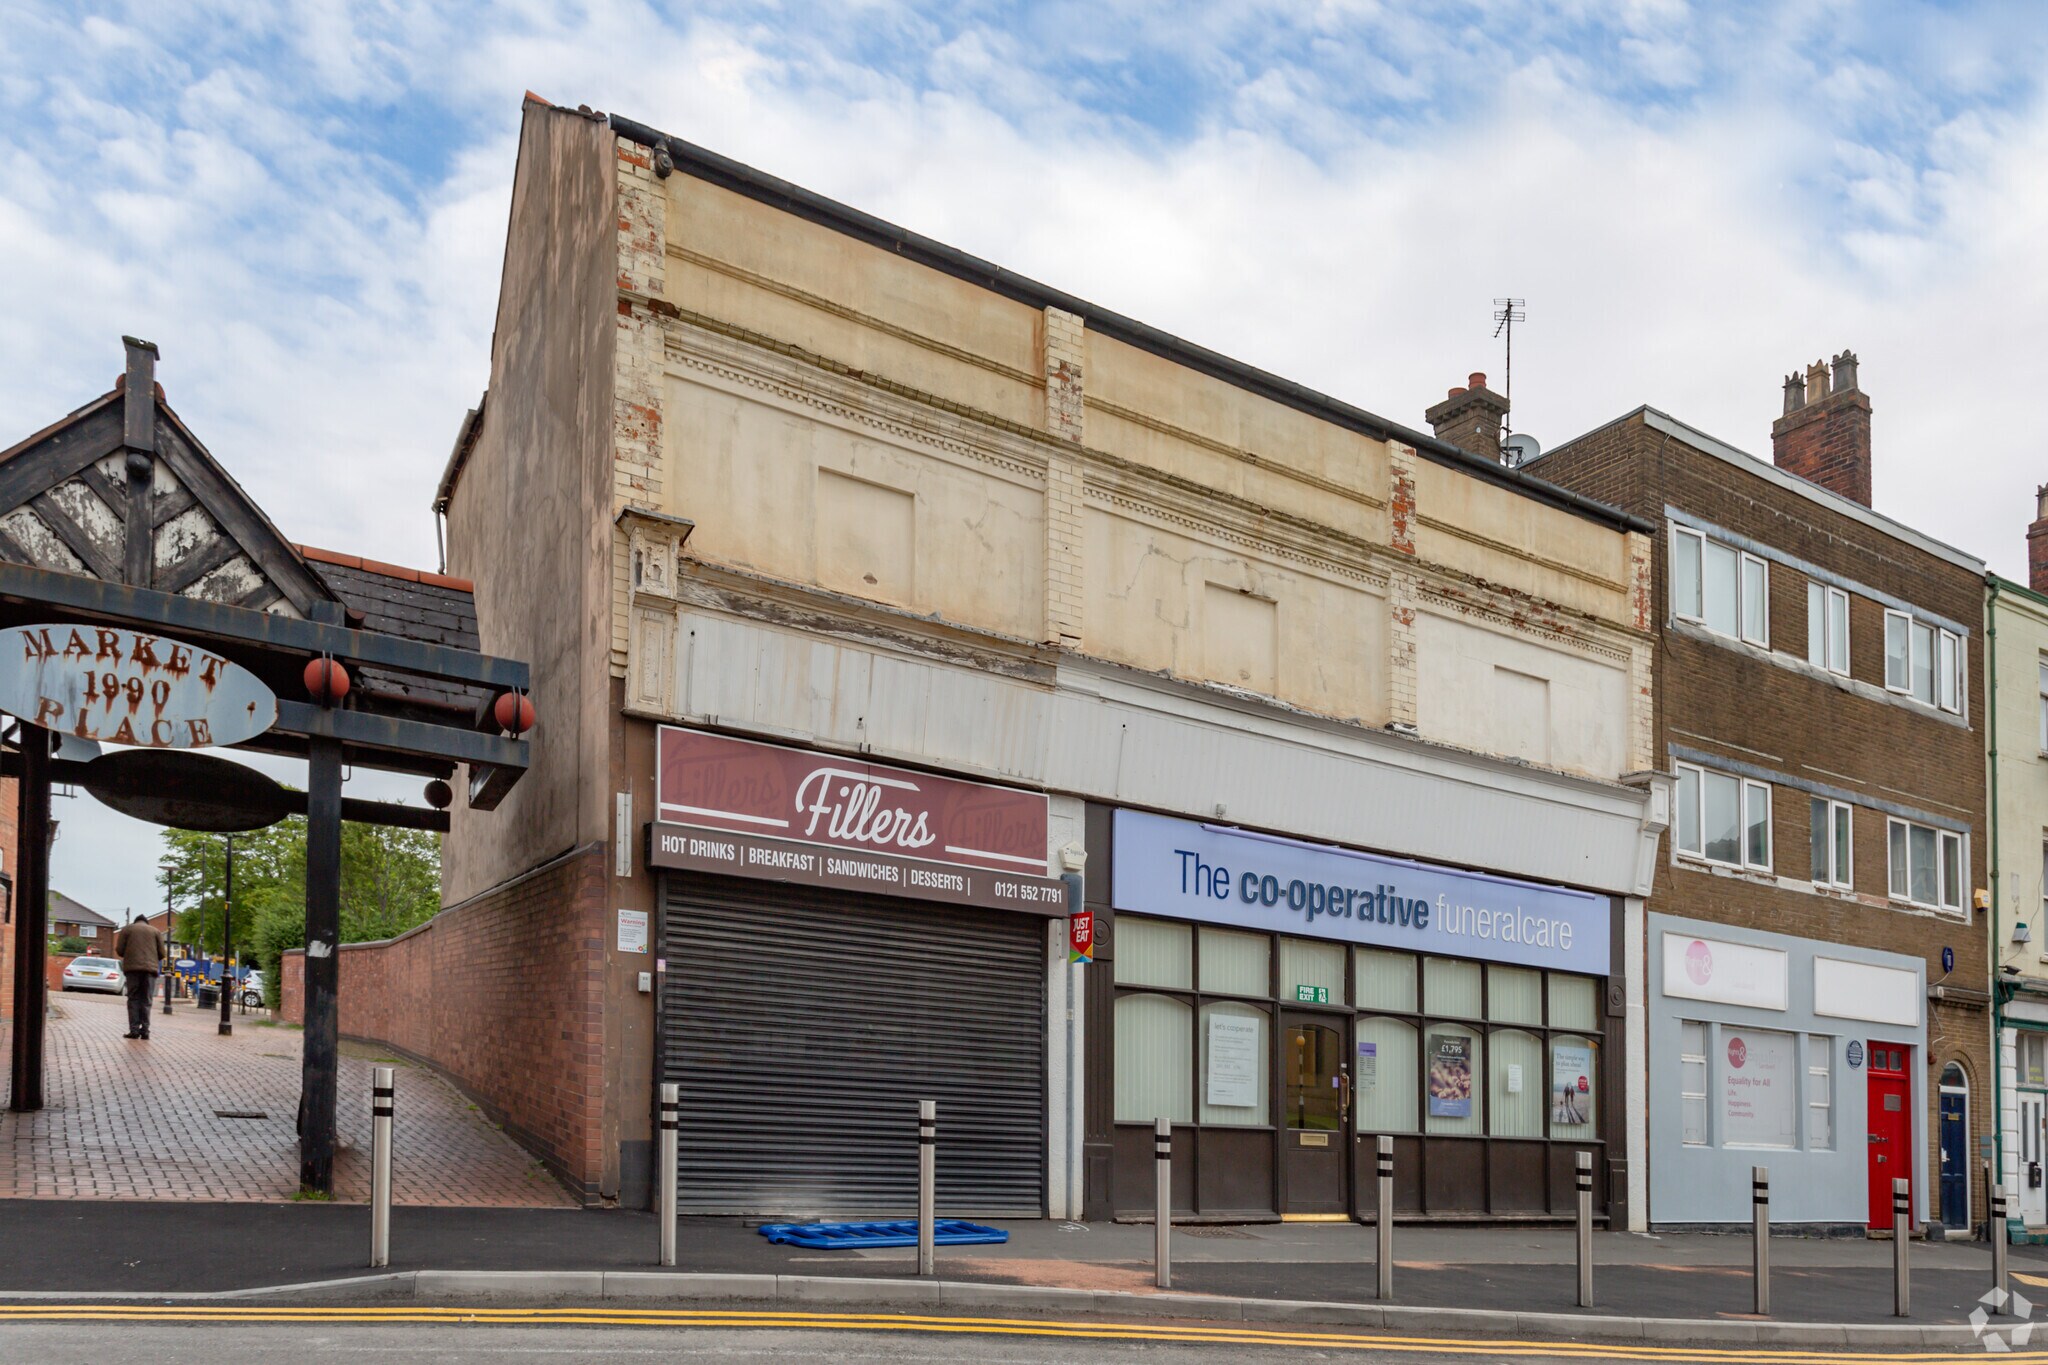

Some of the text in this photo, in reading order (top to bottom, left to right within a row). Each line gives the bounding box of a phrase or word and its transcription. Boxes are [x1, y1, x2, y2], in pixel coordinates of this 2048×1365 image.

[18, 628, 231, 690] MARKET
[83, 670, 171, 706] 1990
[34, 696, 213, 747] PLACE
[795, 767, 936, 848] Fillers
[661, 835, 1062, 903] HOT DRINKS BREAKFAST SANDWICHES DESSERTS 0121 552 7791
[1174, 849, 1573, 951] The co-operative funeralcare
[620, 918, 646, 927] Warning
[1073, 917, 1090, 932] JUST
[1076, 930, 1090, 943] EAT
[1299, 986, 1315, 995] FIRE
[1299, 994, 1315, 1002] EXIT
[1214, 1022, 1226, 1031] let's
[1441, 1044, 1463, 1054] £1,795
[1728, 1076, 1771, 1088] Equality for All
